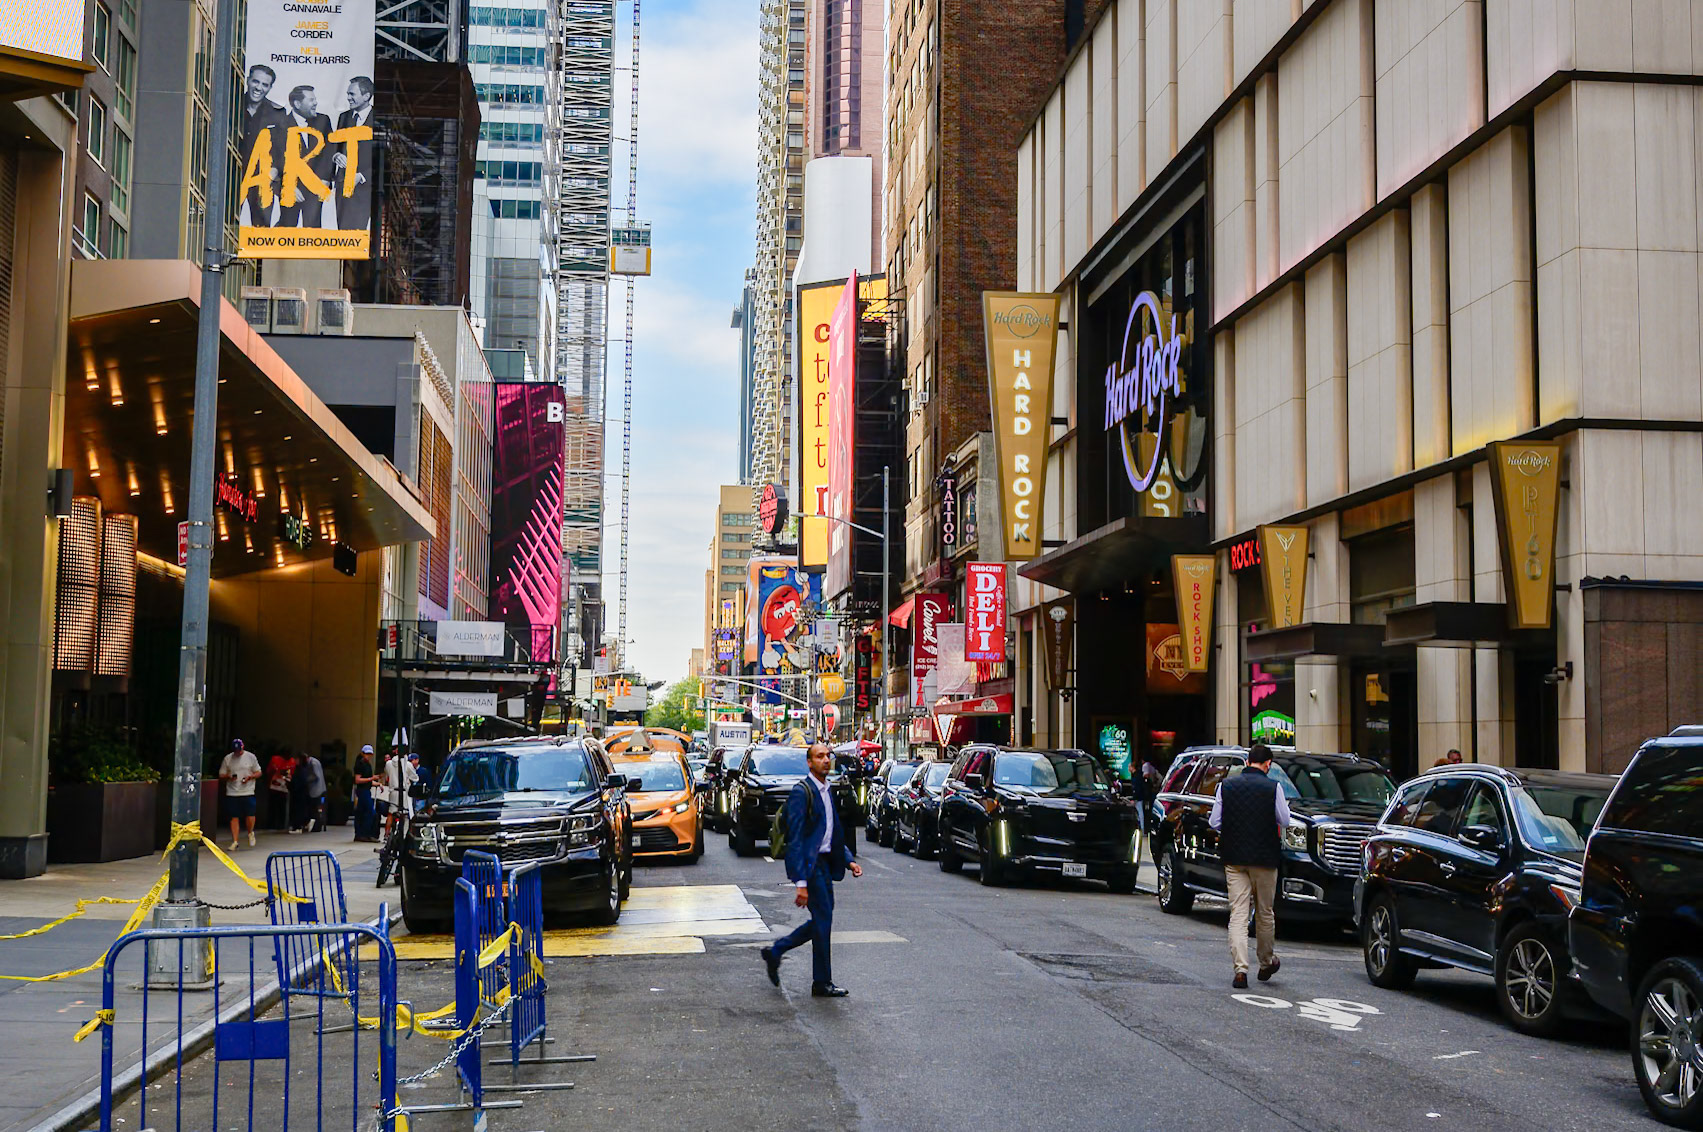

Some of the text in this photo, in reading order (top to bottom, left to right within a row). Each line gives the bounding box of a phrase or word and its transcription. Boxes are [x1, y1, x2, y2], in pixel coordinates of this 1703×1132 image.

[283, 3, 342, 14] CANNAVALE
[290, 30, 333, 39] CORDEN
[295, 21, 329, 30] JAMES
[271, 53, 350, 65] PATRICK HARRIS
[300, 47, 322, 55] NEIL
[240, 126, 373, 208] ART
[247, 237, 362, 247] NOW ON BROADWAY
[994, 311, 1051, 329] Hard Rock
[1104, 313, 1181, 432] Hard Rock
[1013, 349, 1032, 436] HARD
[1507, 455, 1551, 469] Hard Rock
[1013, 454, 1033, 542] ROCK
[943, 479, 955, 545] TATTOO
[1231, 540, 1255, 570] ROCK
[971, 565, 1002, 573] GROCERY
[1283, 553, 1293, 589] THE
[1192, 583, 1201, 621] ROCK
[975, 572, 998, 651] DELI
[453, 631, 500, 641] ALDERMAN
[1193, 625, 1202, 665] SHOP
[445, 697, 493, 707] ALDERMAN
